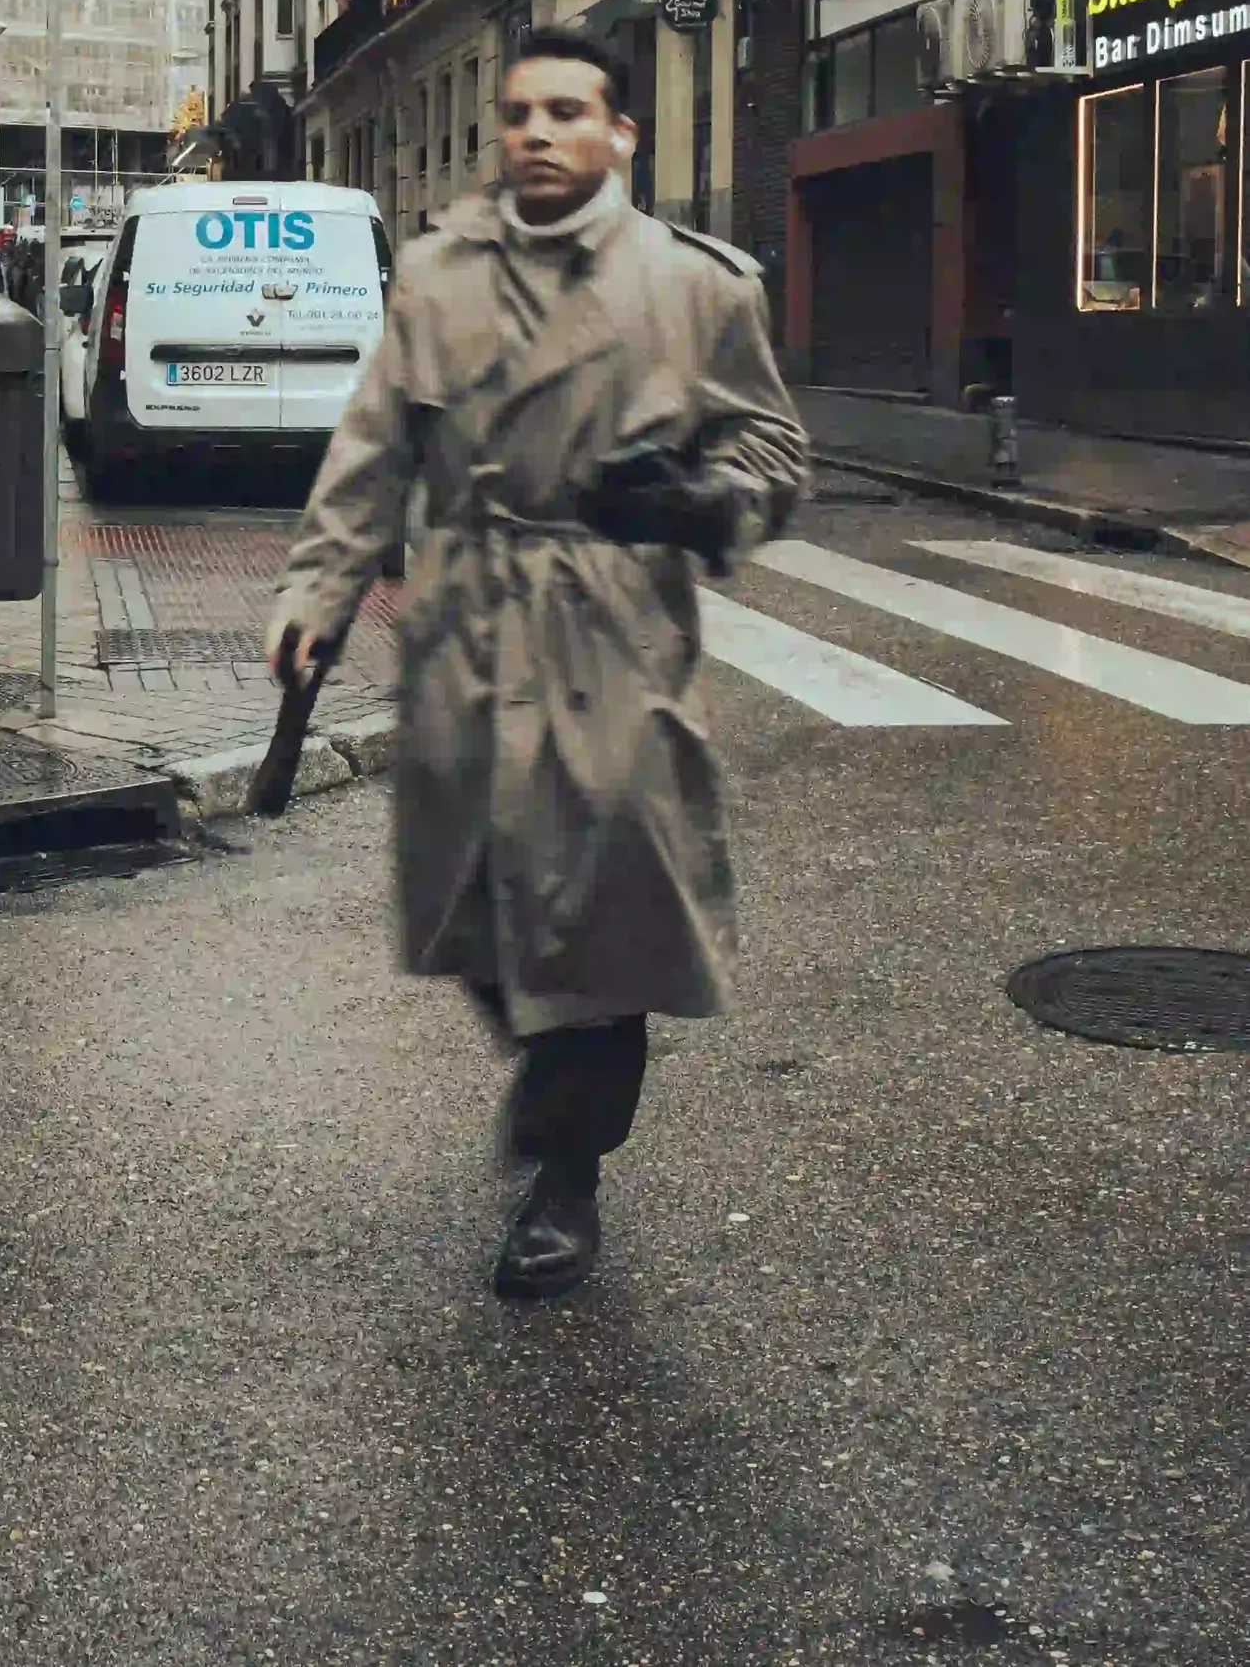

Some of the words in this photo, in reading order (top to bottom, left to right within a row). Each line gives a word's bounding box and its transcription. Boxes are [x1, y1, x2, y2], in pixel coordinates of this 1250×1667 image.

[1095, 33, 1140, 69] Bar
[1146, 3, 1249, 55] Dimsum
[195, 211, 316, 251] OTIS
[146, 282, 166, 294] Su
[172, 279, 255, 297] Seguridad
[306, 281, 369, 297] Primero
[180, 365, 225, 382] 3602
[230, 365, 264, 382] LZR
